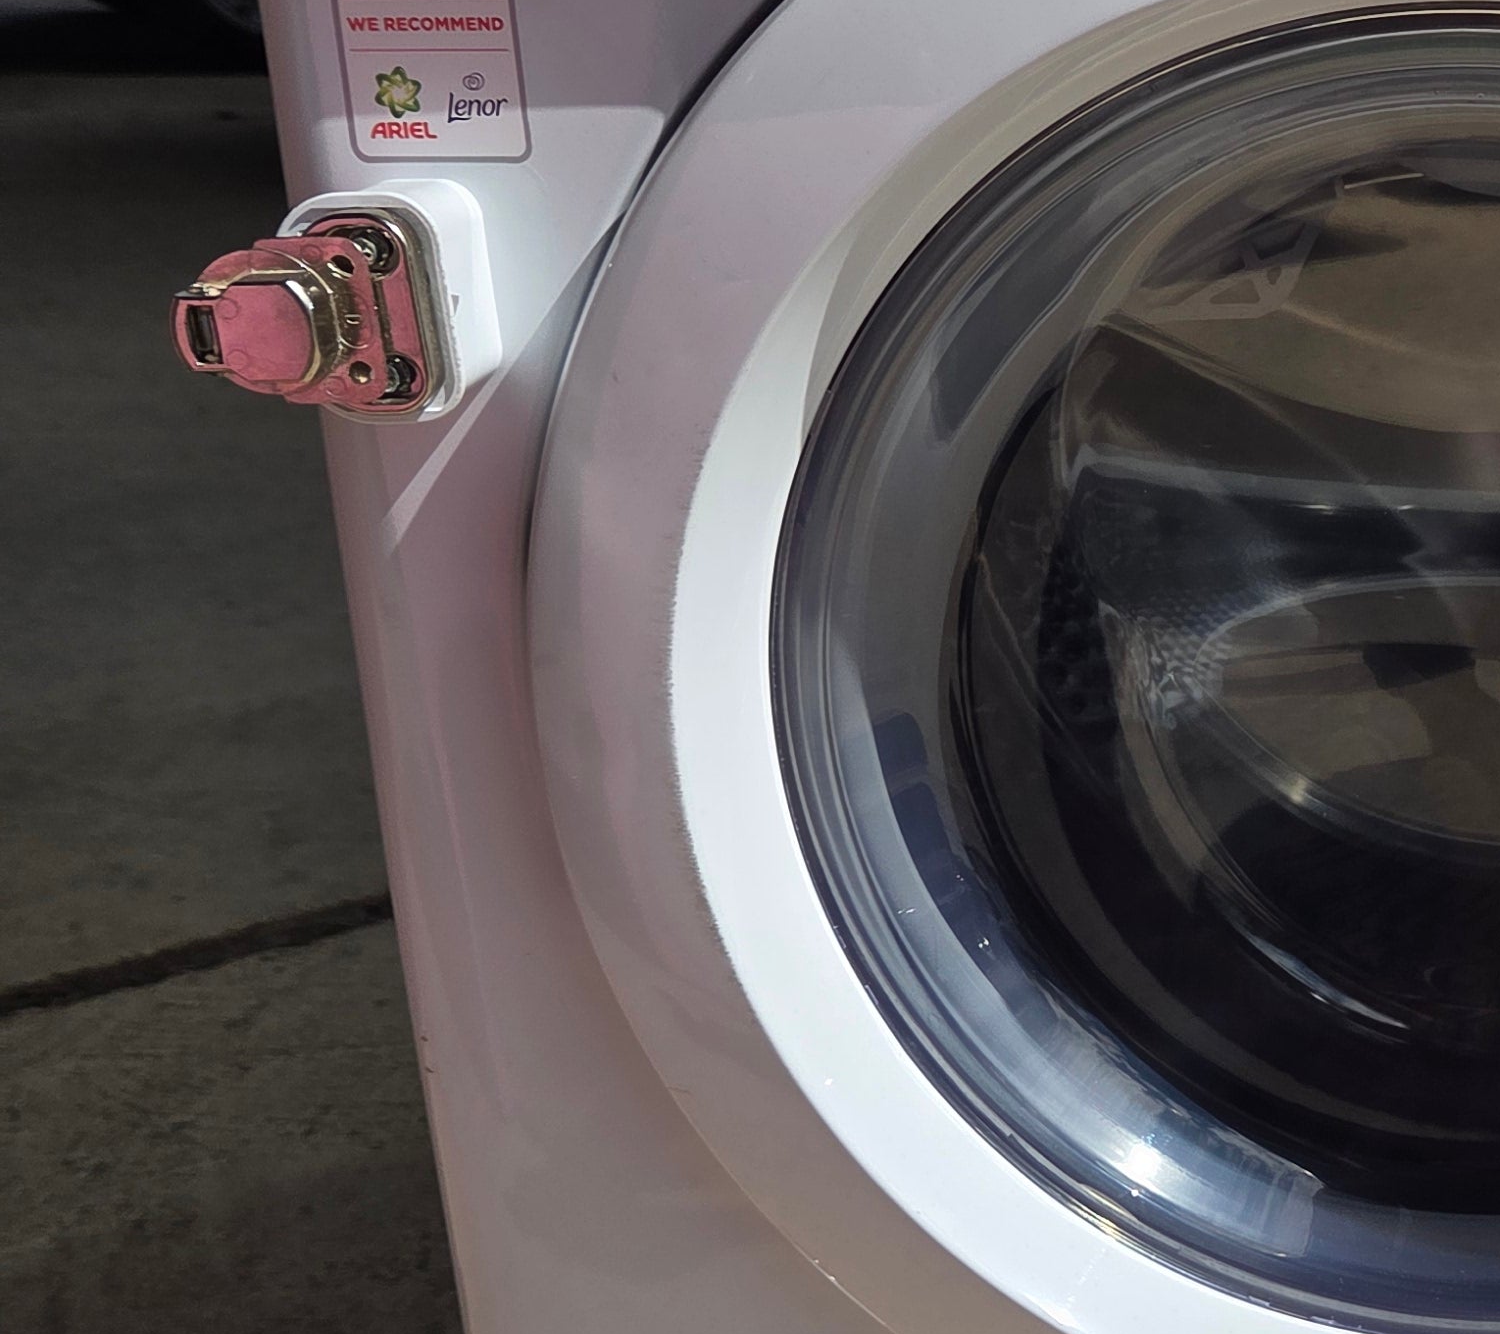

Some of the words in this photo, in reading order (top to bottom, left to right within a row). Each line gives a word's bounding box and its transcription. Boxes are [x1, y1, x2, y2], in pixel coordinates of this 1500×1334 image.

[347, 17, 379, 31] WE
[384, 17, 504, 31] RECOMMEND
[448, 92, 508, 123] Lenor
[370, 122, 437, 139] ARIEL
